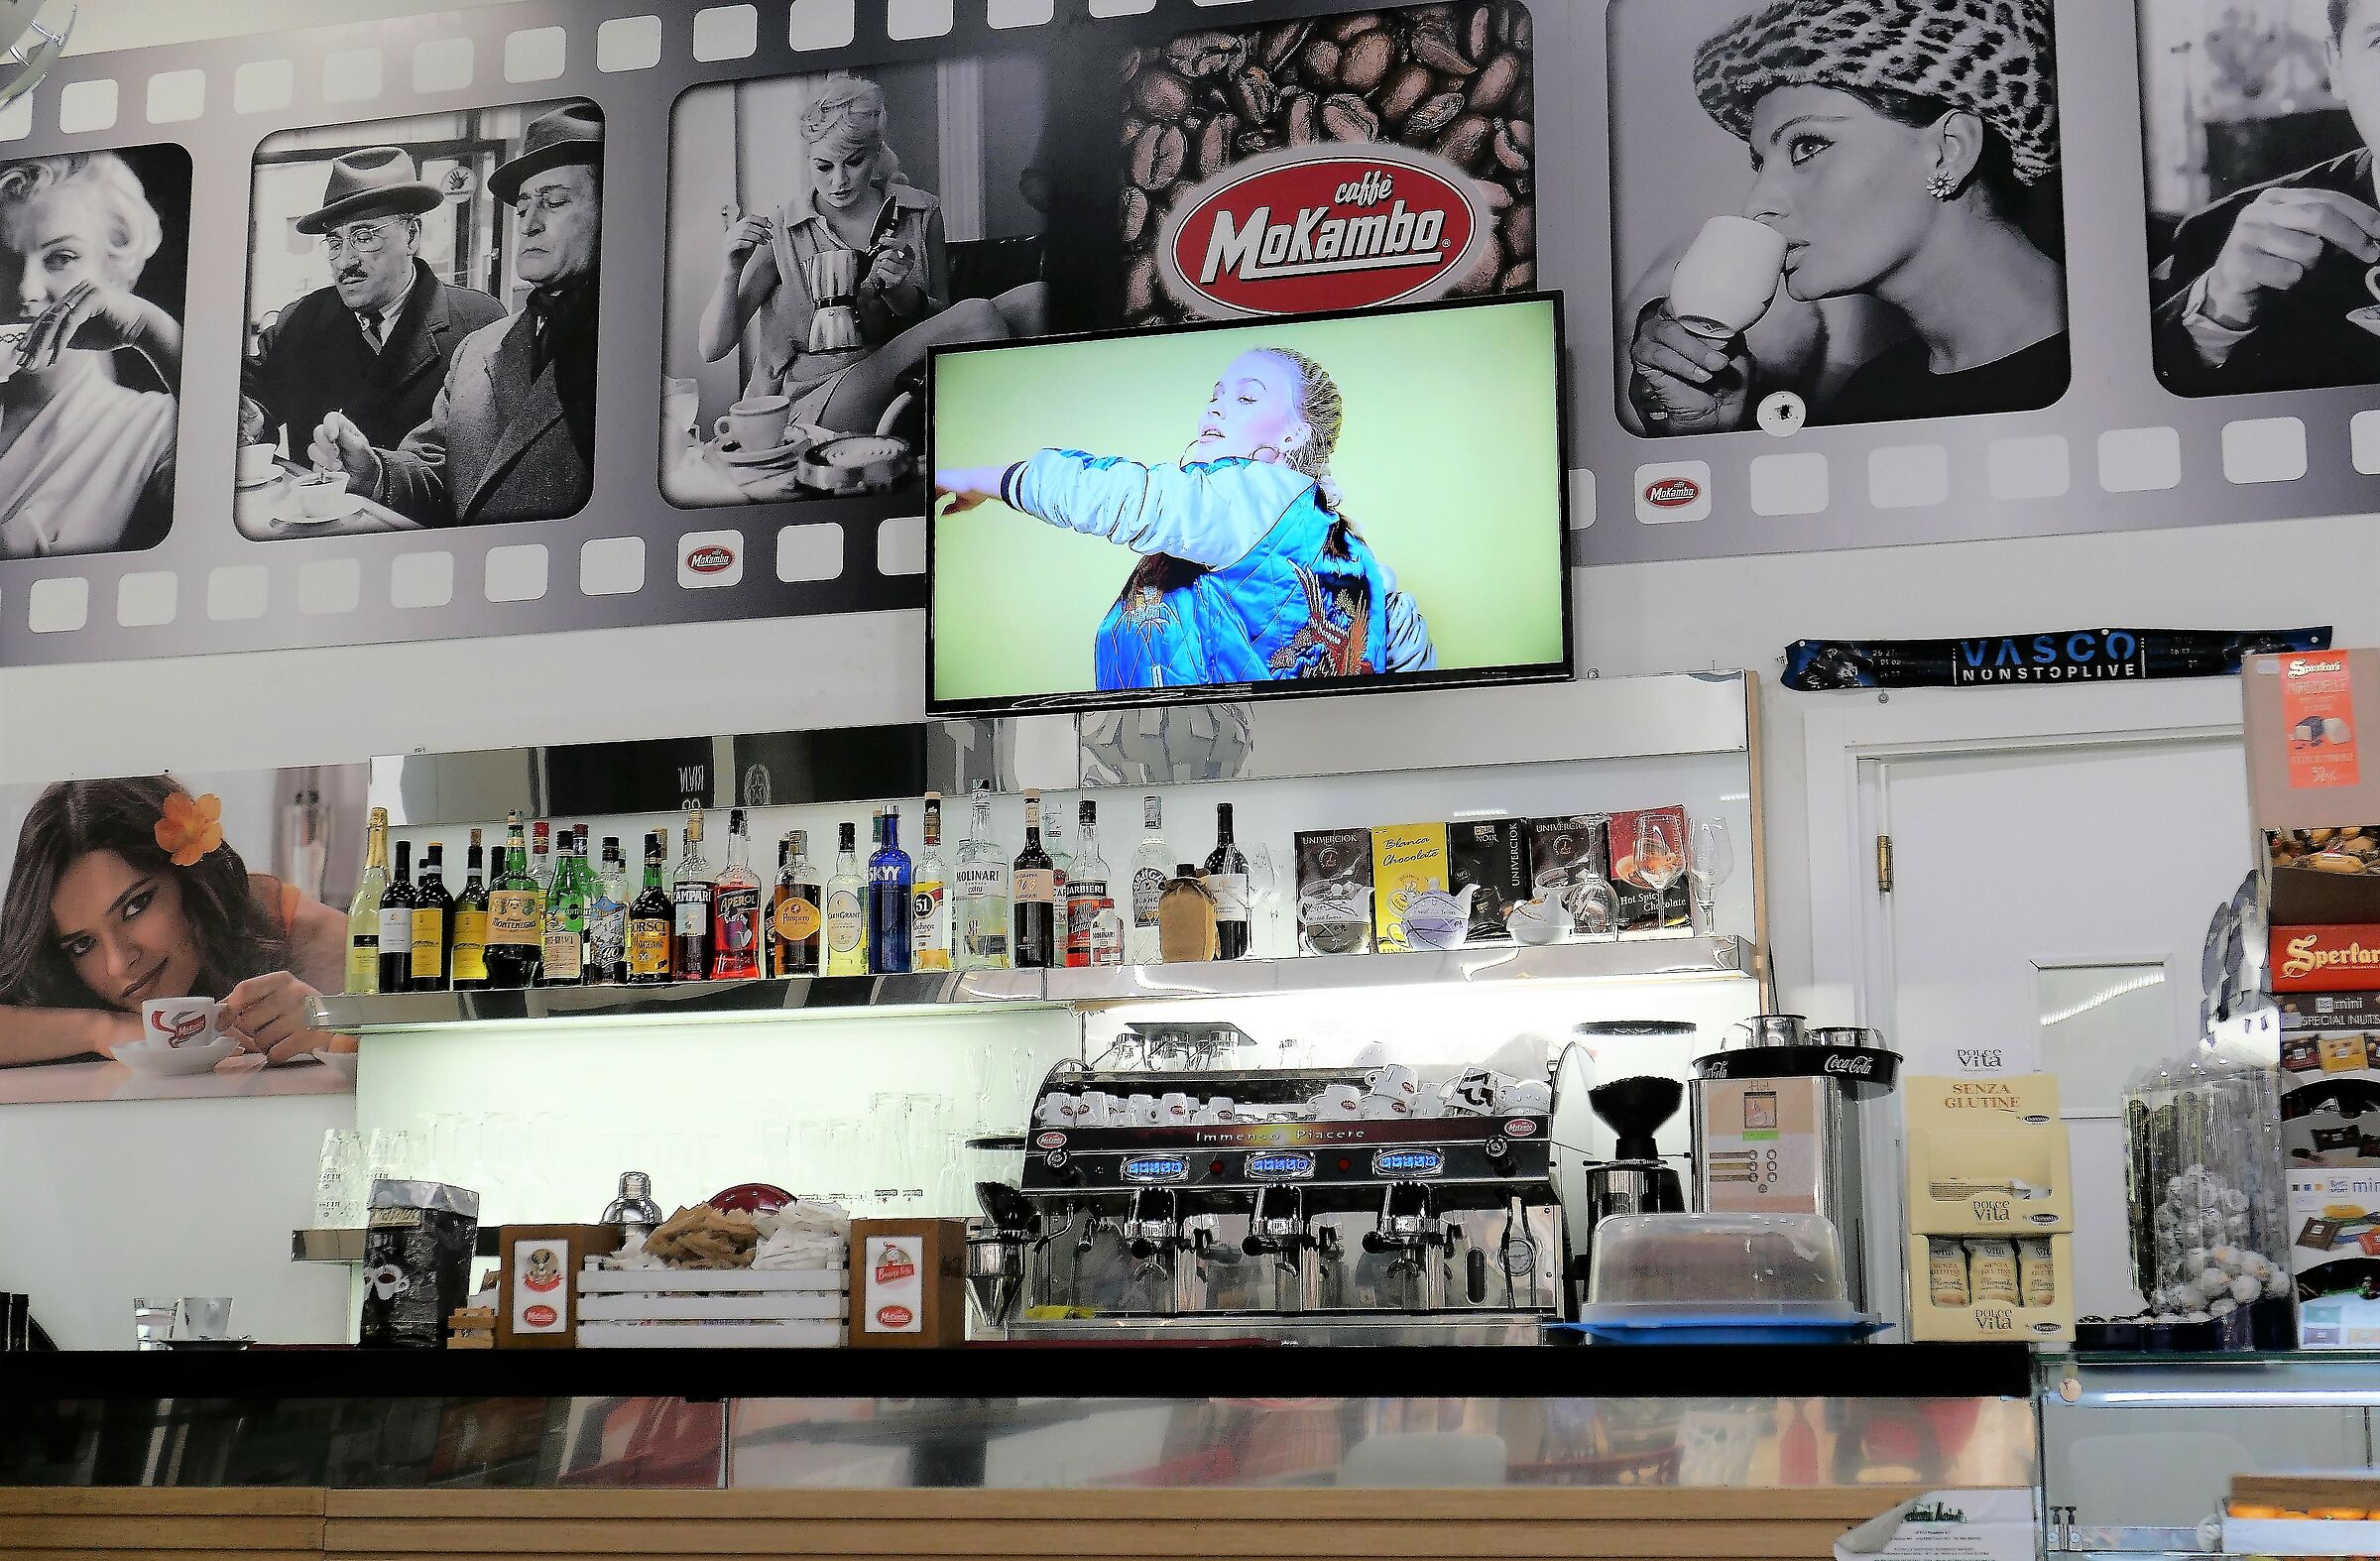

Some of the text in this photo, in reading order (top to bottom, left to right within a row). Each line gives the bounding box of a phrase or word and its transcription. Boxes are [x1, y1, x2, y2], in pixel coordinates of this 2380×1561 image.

[1334, 169, 1393, 206] caffè
[1199, 200, 1446, 286] MoKambo
[1961, 631, 2135, 667] VASCO
[1382, 837, 1430, 850] Blanca
[1508, 822, 1520, 887] UNIVERCIOK
[869, 866, 900, 882] SKYY
[915, 897, 930, 912] 51
[2301, 1015, 2346, 1026] SPECIAL
[1824, 1053, 1873, 1075] Coca-Cola
[1953, 1083, 2011, 1095] SENZA
[1944, 1096, 2021, 1109] GLUTINE
[1196, 1129, 1365, 1142] Immenso Piacere
